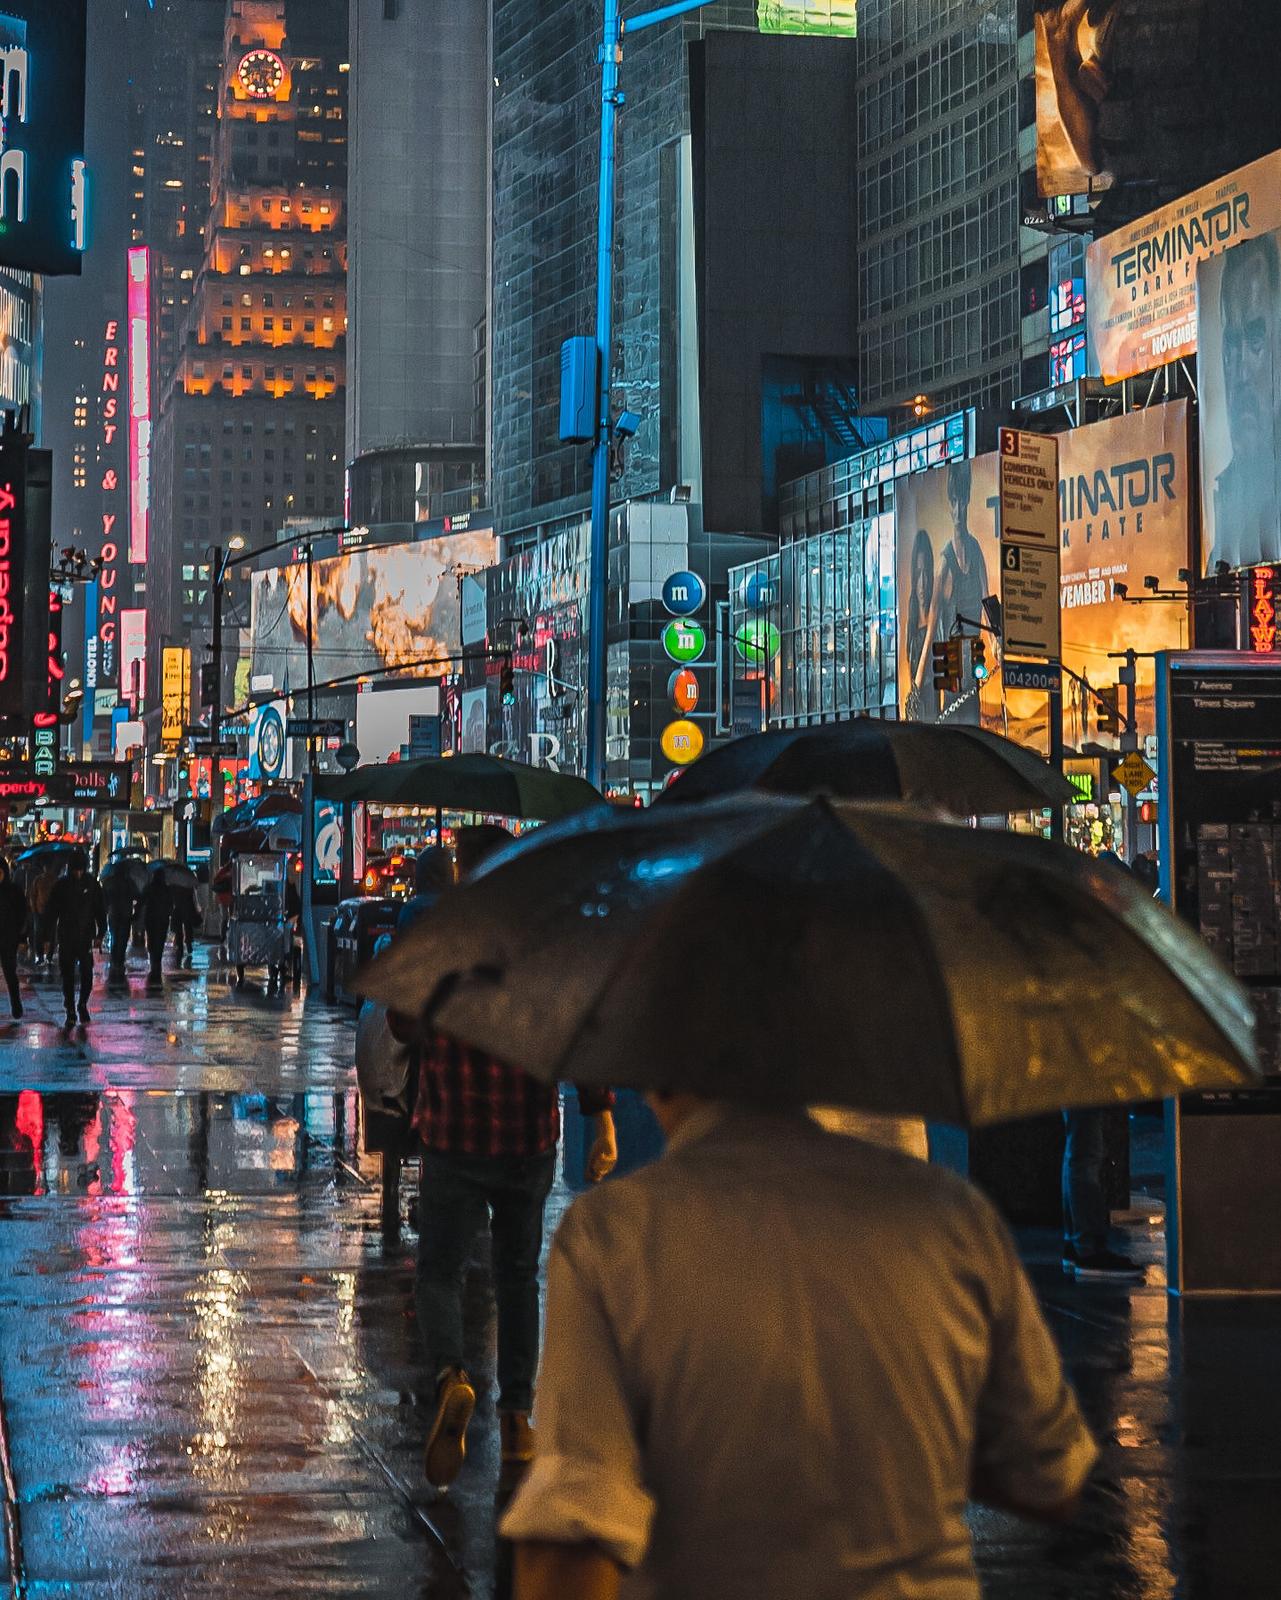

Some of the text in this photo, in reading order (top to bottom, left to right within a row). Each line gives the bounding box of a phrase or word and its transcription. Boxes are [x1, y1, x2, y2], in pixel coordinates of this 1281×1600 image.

[1111, 191, 1251, 289] TERMINATOR
[1131, 268, 1174, 302] DARK
[1151, 319, 1197, 356] NOVEMBE
[103, 320, 120, 444] ERNST
[1005, 432, 1015, 454] 3
[102, 468, 118, 490] &
[1003, 462, 1047, 478] COMMERCIAL
[1003, 474, 1055, 491] VEHICLES ONLY
[1086, 512, 1142, 544] FATE
[1005, 548, 1016, 569] 6
[100, 513, 118, 641] YOUNG
[672, 586, 689, 601] m
[1060, 579, 1106, 609] VEMBER
[677, 633, 695, 650] m
[86, 635, 98, 688] KNOTEL
[1004, 670, 1048, 689] 104200
[686, 683, 697, 699] m
[35, 728, 56, 776] BAR
[1124, 770, 1144, 778] LANE
